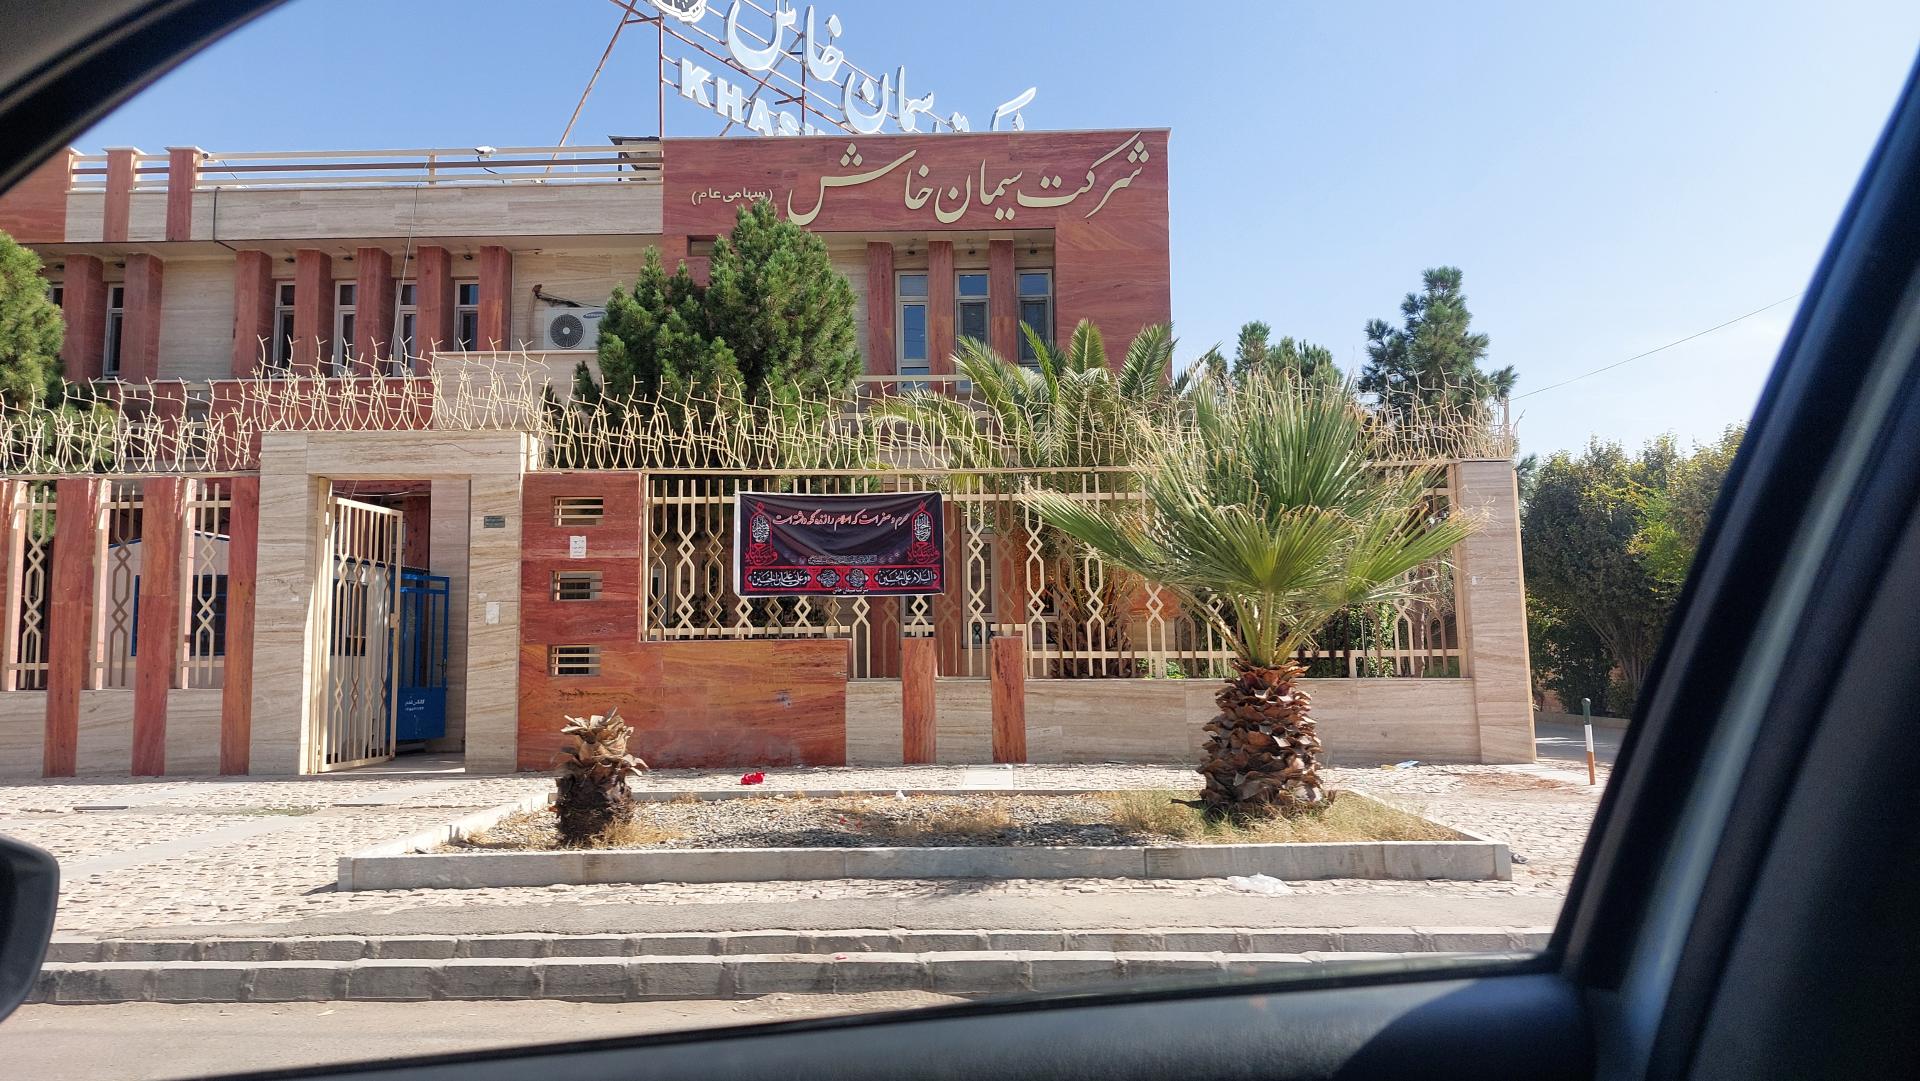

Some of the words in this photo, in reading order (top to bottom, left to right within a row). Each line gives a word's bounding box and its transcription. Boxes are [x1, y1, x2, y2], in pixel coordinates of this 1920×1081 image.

[787, 142, 935, 226] خاش
[934, 158, 1023, 224] سیمان
[1016, 130, 1150, 218] شرکت
[772, 514, 793, 525] است
[833, 514, 852, 532] اسلام
[858, 514, 879, 525] است
